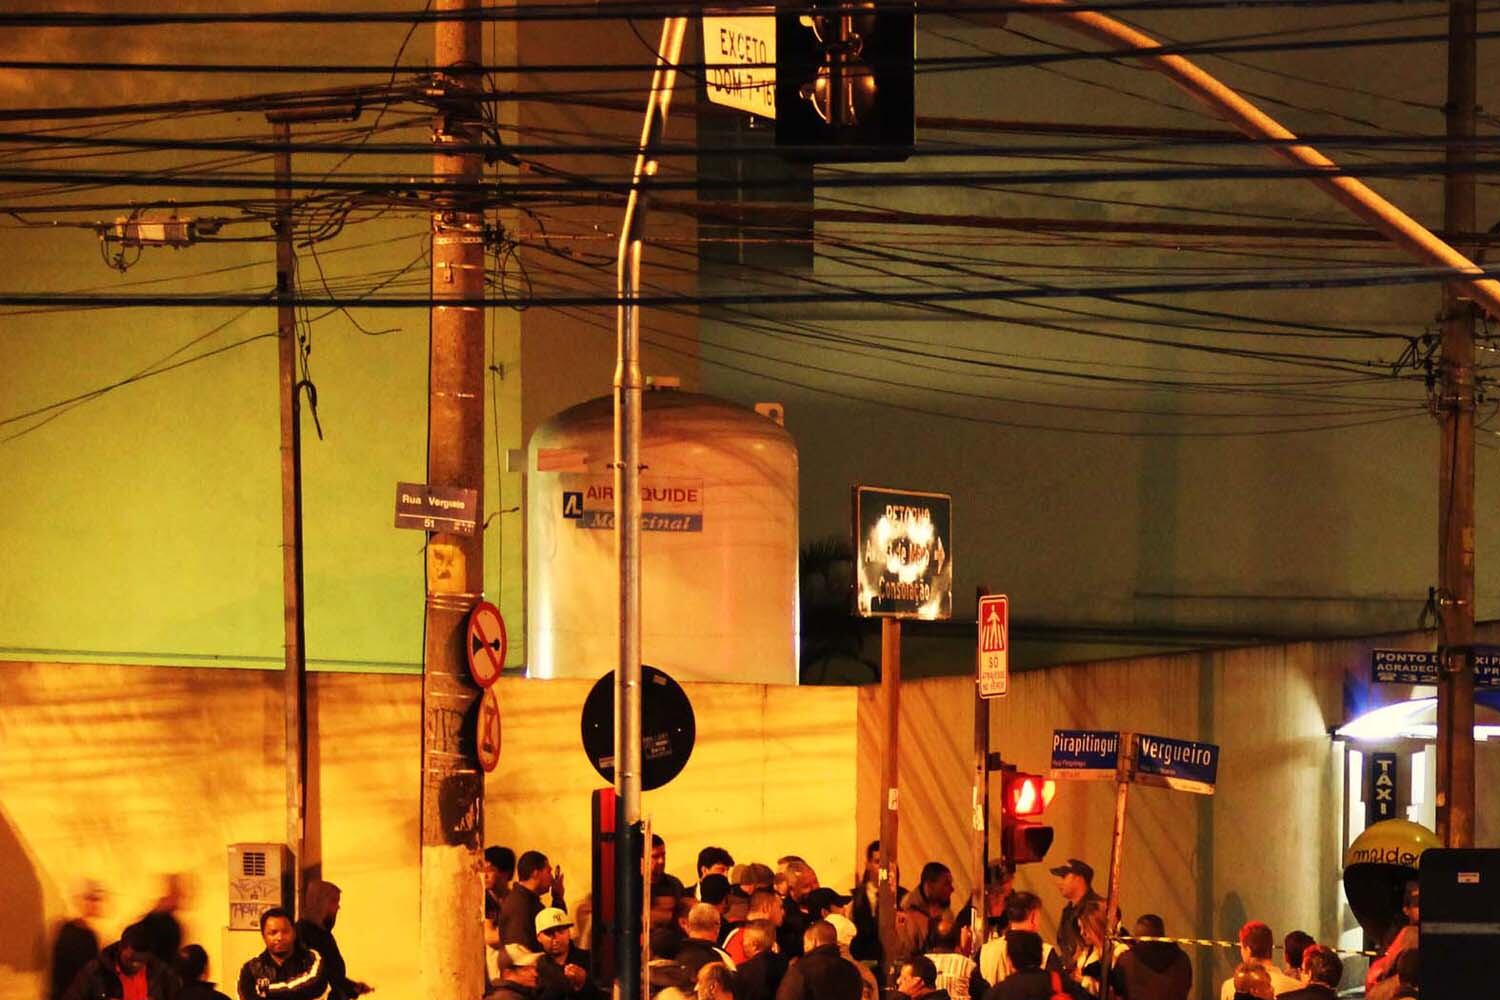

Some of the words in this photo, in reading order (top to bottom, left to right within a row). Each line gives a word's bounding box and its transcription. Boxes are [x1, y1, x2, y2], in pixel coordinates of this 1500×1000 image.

[720, 28, 768, 64] EXCETO
[402, 494, 421, 504] Rua
[641, 487, 699, 503] QUIDE
[424, 519, 435, 529] 51
[1375, 653, 1427, 663] PONTO
[1053, 732, 1118, 757] Pirapitingui
[1142, 736, 1211, 766] Vergueiro
